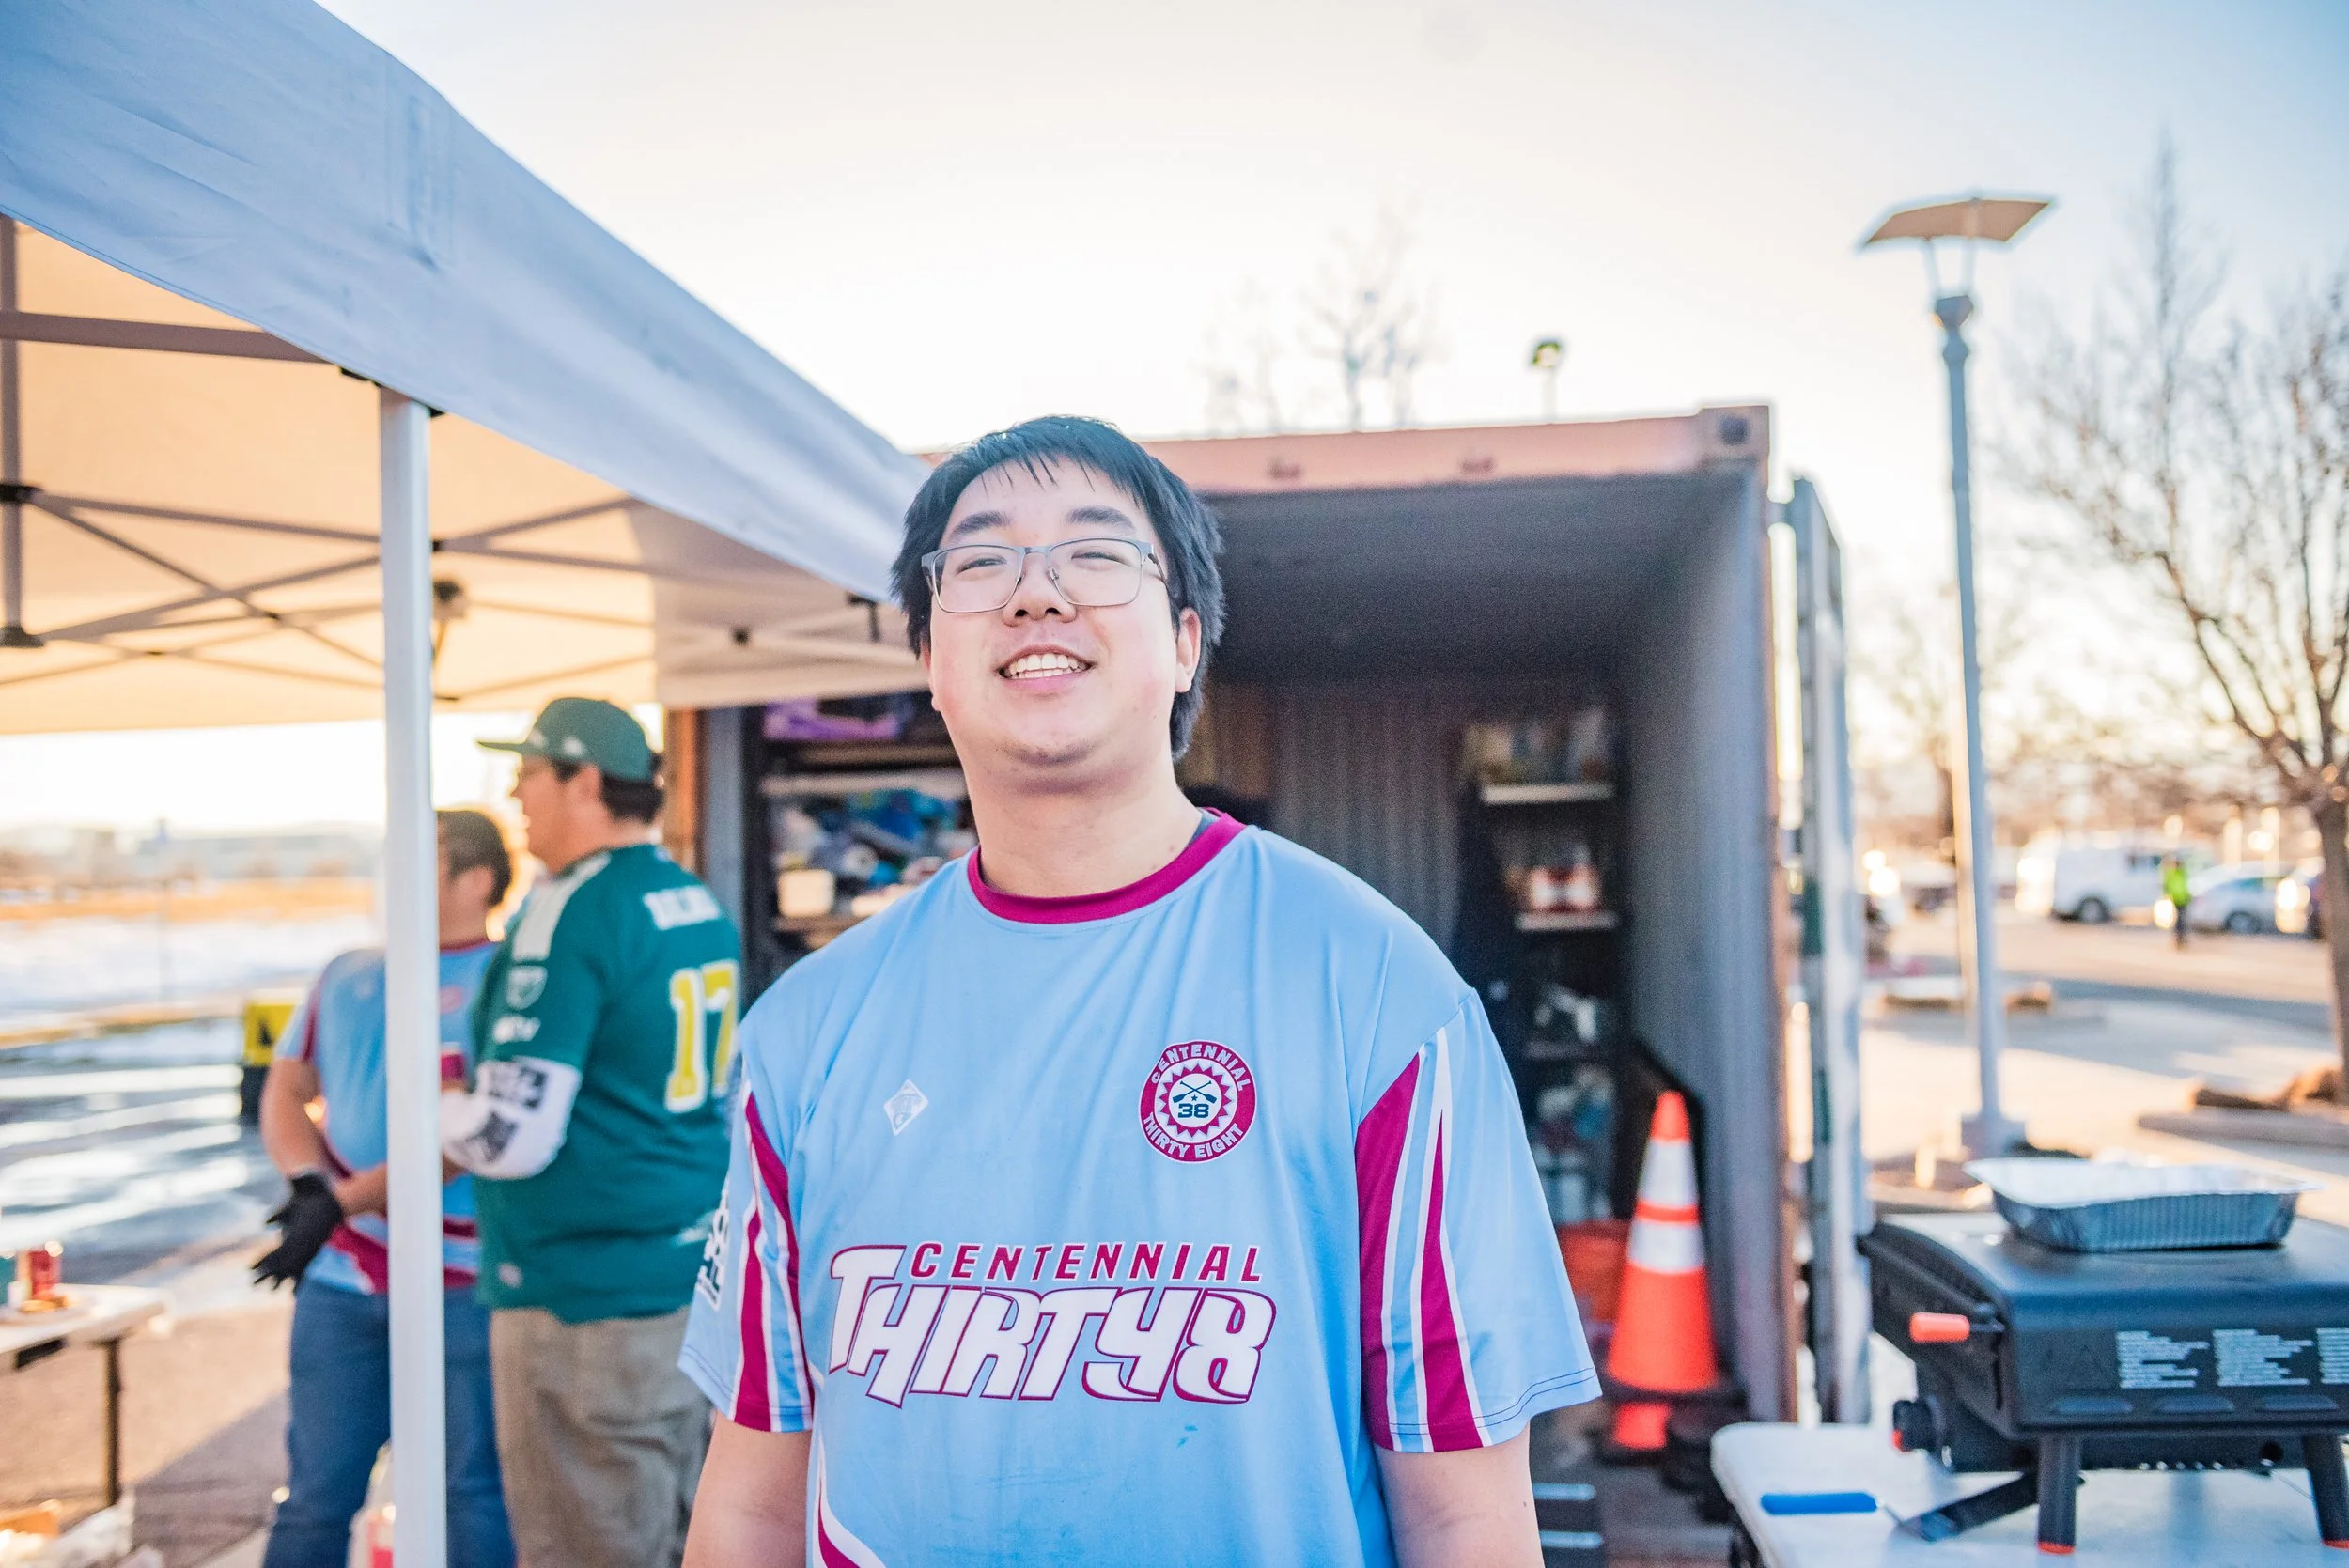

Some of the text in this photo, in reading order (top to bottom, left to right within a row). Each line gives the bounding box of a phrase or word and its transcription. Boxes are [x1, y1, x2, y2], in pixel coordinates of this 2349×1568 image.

[664, 959, 739, 1113] 17
[1150, 1044, 1251, 1092] CENTENNIAL
[1177, 1103, 1209, 1119] 38
[1143, 1112, 1244, 1158] THIRTY EIGHT
[909, 1242, 1264, 1282] CENTENNIAL
